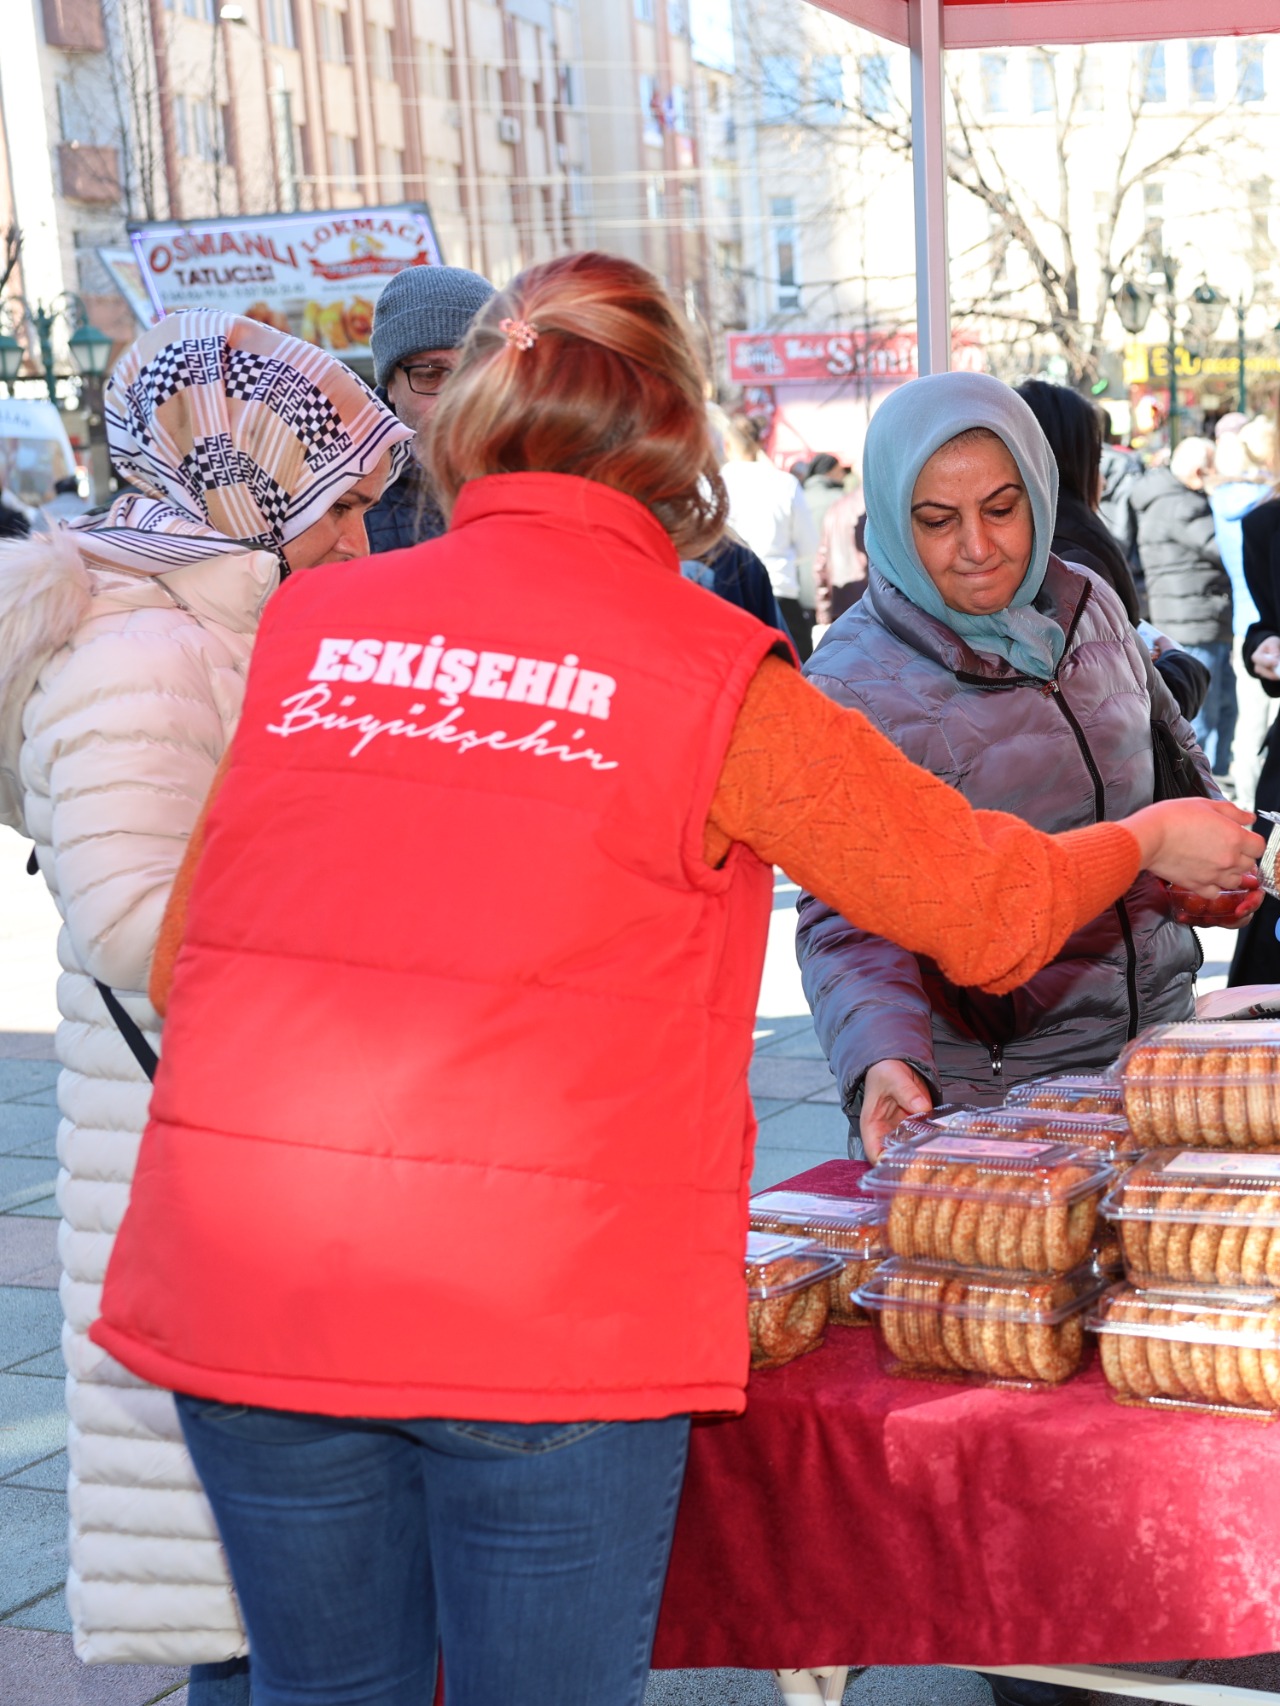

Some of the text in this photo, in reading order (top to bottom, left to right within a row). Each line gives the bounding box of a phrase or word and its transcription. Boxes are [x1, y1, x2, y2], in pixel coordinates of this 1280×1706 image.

[149, 230, 298, 273] OSMANLI
[302, 219, 426, 253] LOKMACI
[175, 264, 275, 287] TATLICISI
[308, 634, 617, 720] ESKİŞEHİR
[266, 682, 620, 770] Büyükşehir
